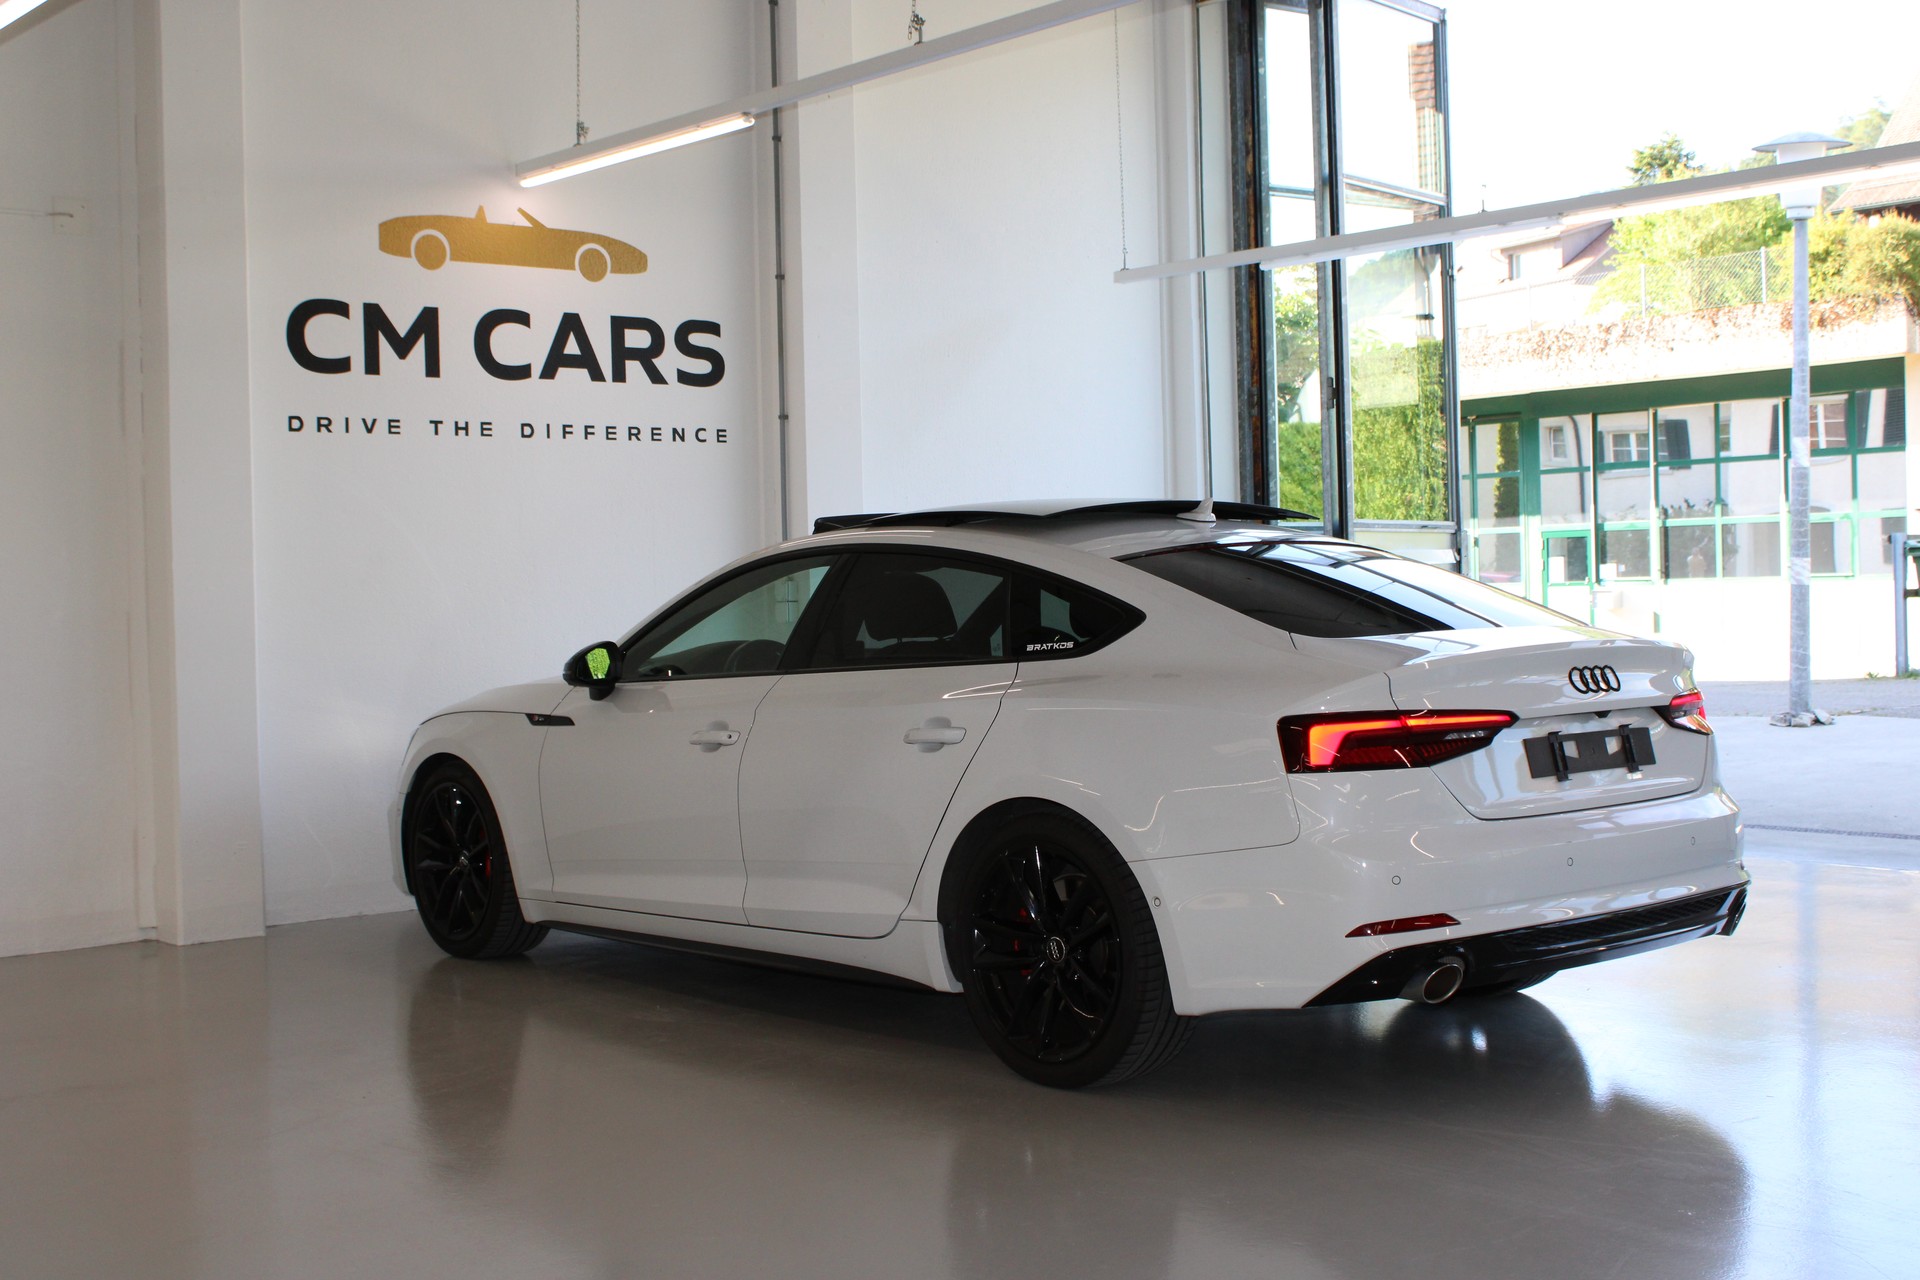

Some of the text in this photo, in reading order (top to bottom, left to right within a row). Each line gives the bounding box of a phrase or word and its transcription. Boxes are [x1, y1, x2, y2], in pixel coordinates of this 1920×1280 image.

[286, 298, 726, 387] CM CARS
[287, 415, 729, 444] DRIVE THE DIFFERENCE
[1026, 641, 1075, 652] BRATKOS
